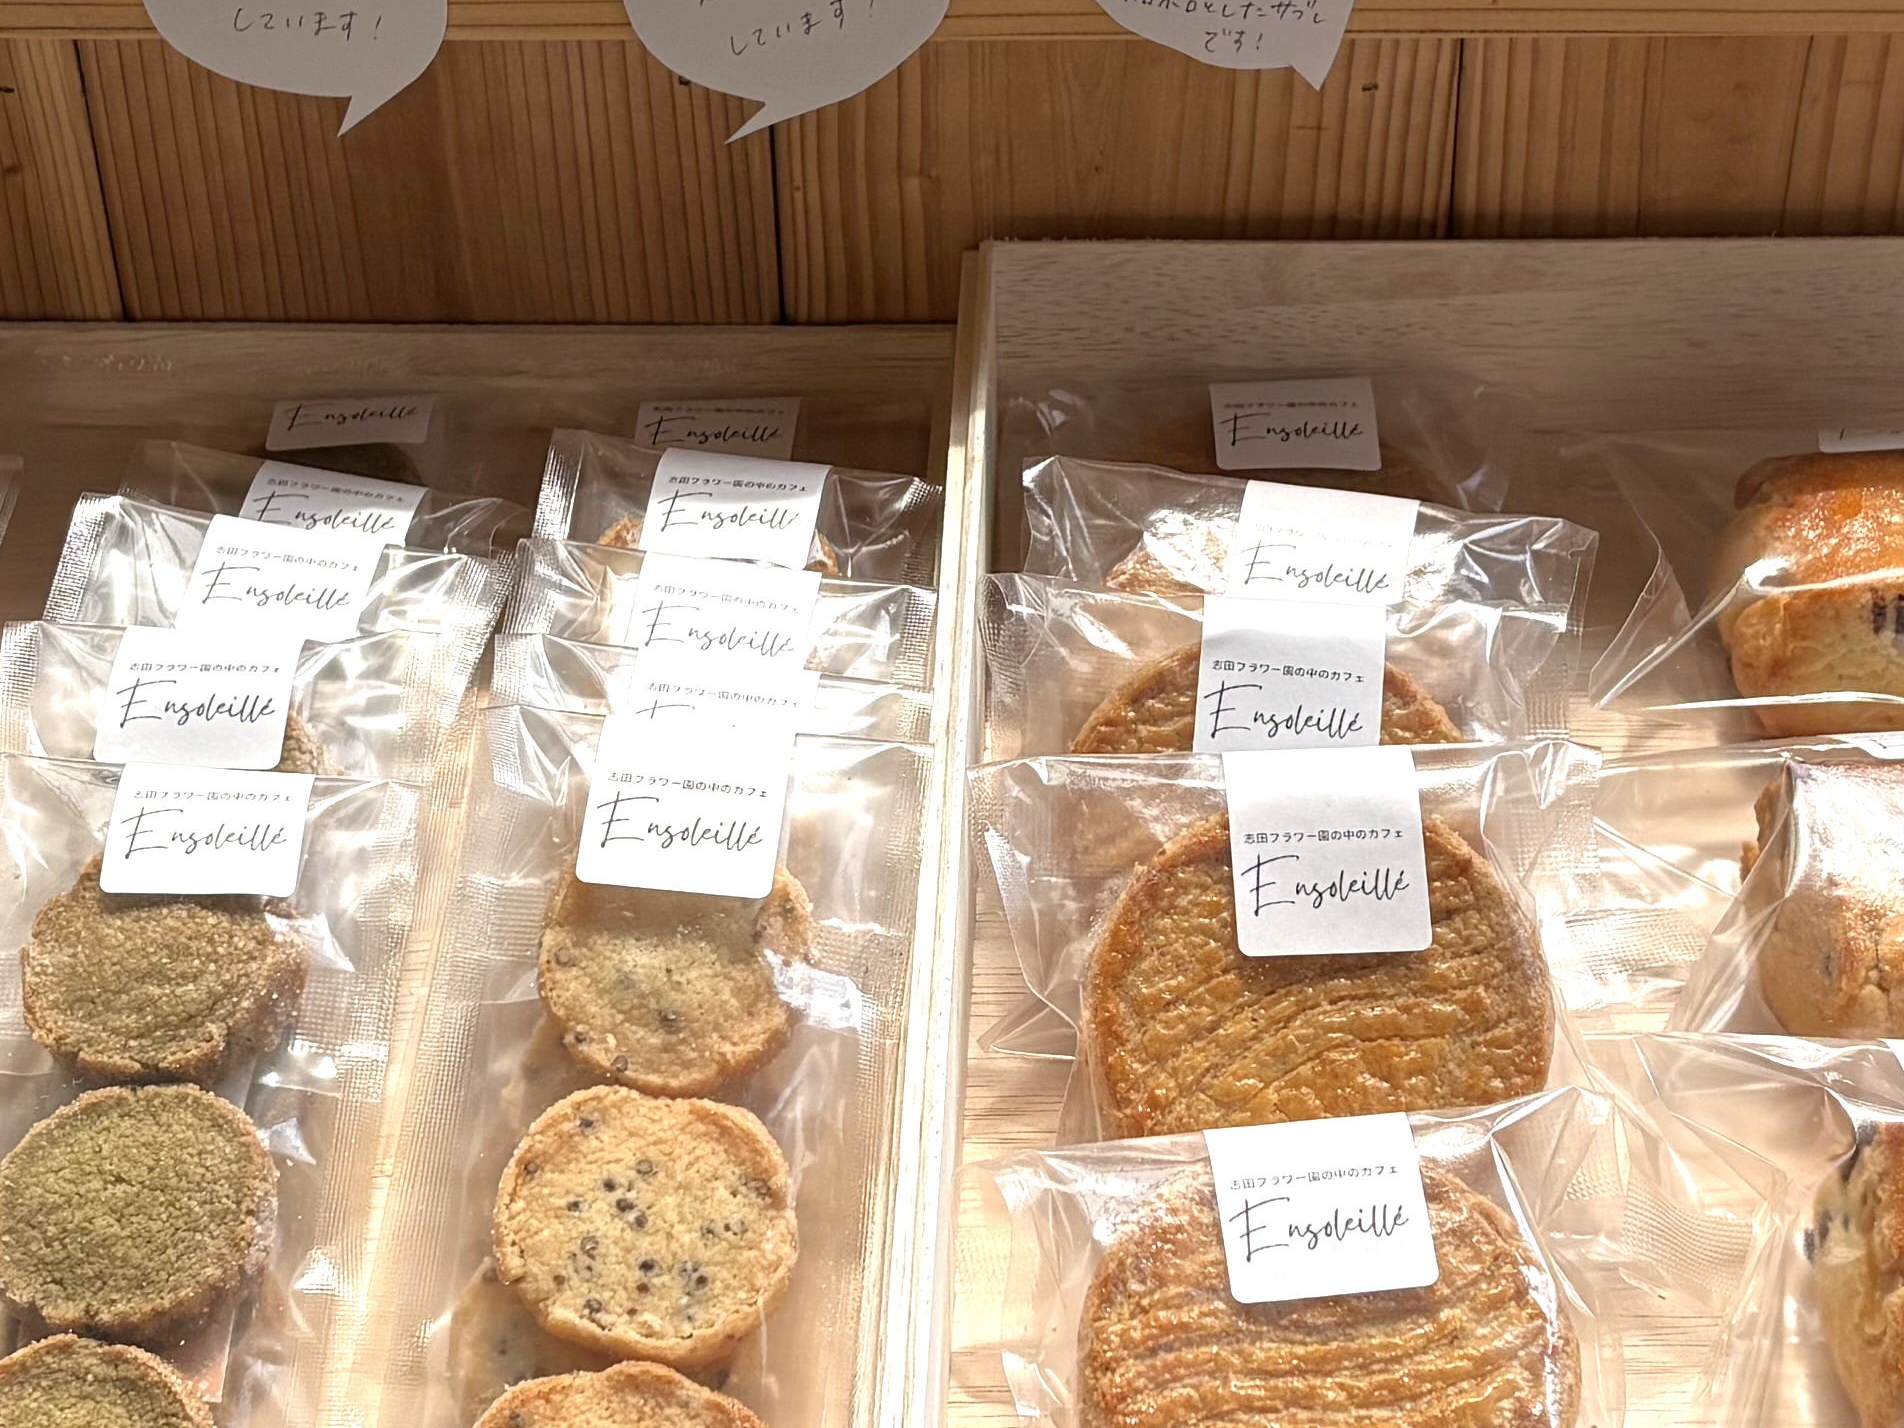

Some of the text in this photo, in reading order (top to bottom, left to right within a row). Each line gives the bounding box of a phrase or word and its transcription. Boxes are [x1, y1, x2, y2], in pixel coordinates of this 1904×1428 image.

[233, 8, 383, 41] しています！
[1204, 29, 1264, 53] です！
[1203, 680, 1363, 739] Ensoleillé
[596, 791, 763, 853] Ensoleillé
[1243, 828, 1404, 845] 志田フラワー園の中のカフェ
[1241, 854, 1410, 917] Ensoleillé
[1228, 1196, 1410, 1263] Ensoleillé
